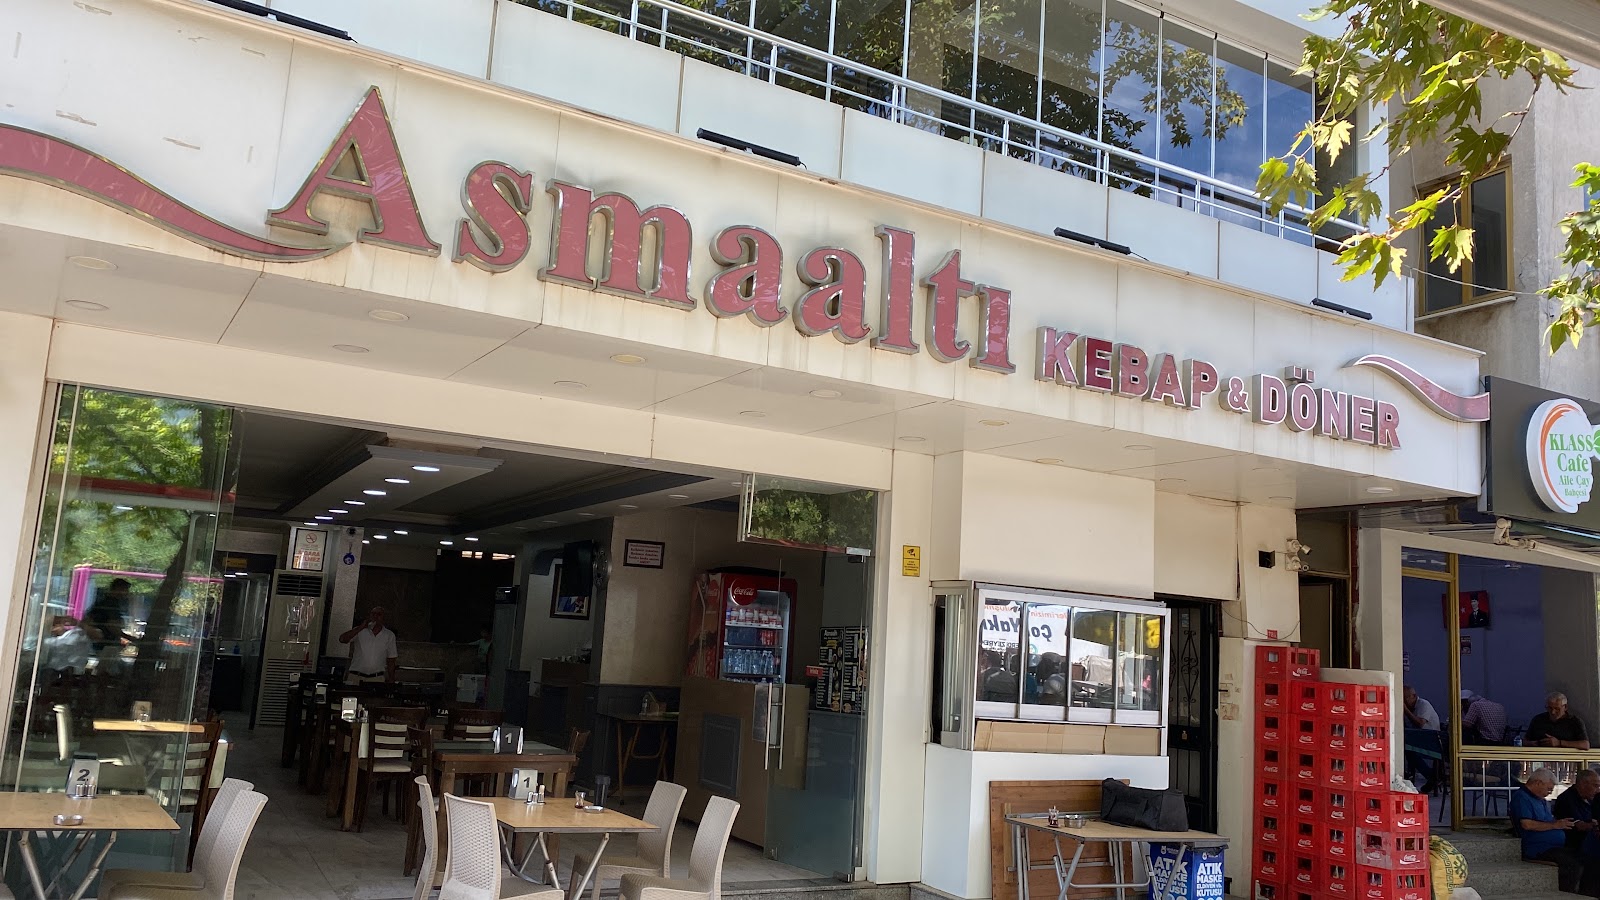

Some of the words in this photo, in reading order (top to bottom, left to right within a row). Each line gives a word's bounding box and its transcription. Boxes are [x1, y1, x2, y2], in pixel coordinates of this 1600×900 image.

[265, 85, 1016, 374] Asmaaltı
[1035, 326, 1219, 411] KEBAP
[1218, 376, 1251, 414] &
[1252, 366, 1401, 449] DÖNER
[1549, 434, 1593, 452] KLASS
[1557, 453, 1589, 472] Cafe
[1559, 475, 1574, 485] Aile
[1576, 475, 1590, 488] Çay
[505, 732, 513, 744] 1
[77, 769, 90, 781] 2
[523, 777, 530, 788] 1
[1197, 862, 1222, 875] ATIK
[1197, 874, 1222, 883] MASKE
[1197, 888, 1222, 897] KUTUSU
